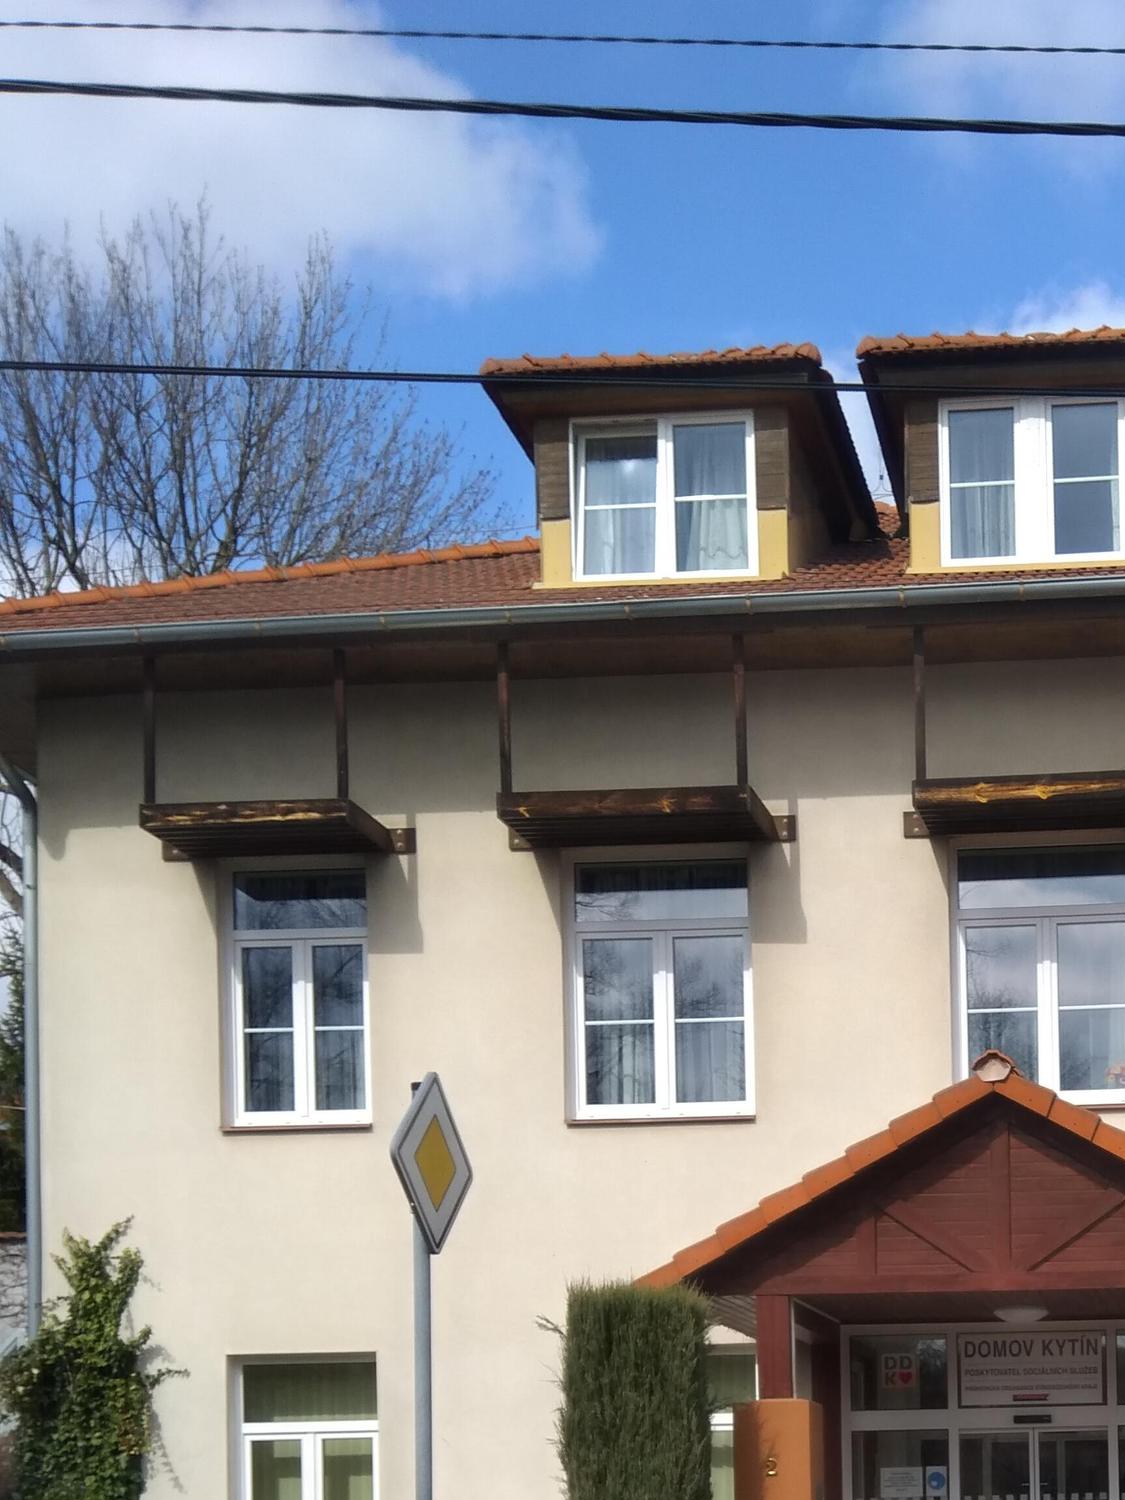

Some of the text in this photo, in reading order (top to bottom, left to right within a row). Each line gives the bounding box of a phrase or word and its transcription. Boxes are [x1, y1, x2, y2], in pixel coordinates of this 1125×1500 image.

[964, 1335, 1098, 1358] DOMOV KYTÍN
[766, 1457, 778, 1477] 2
